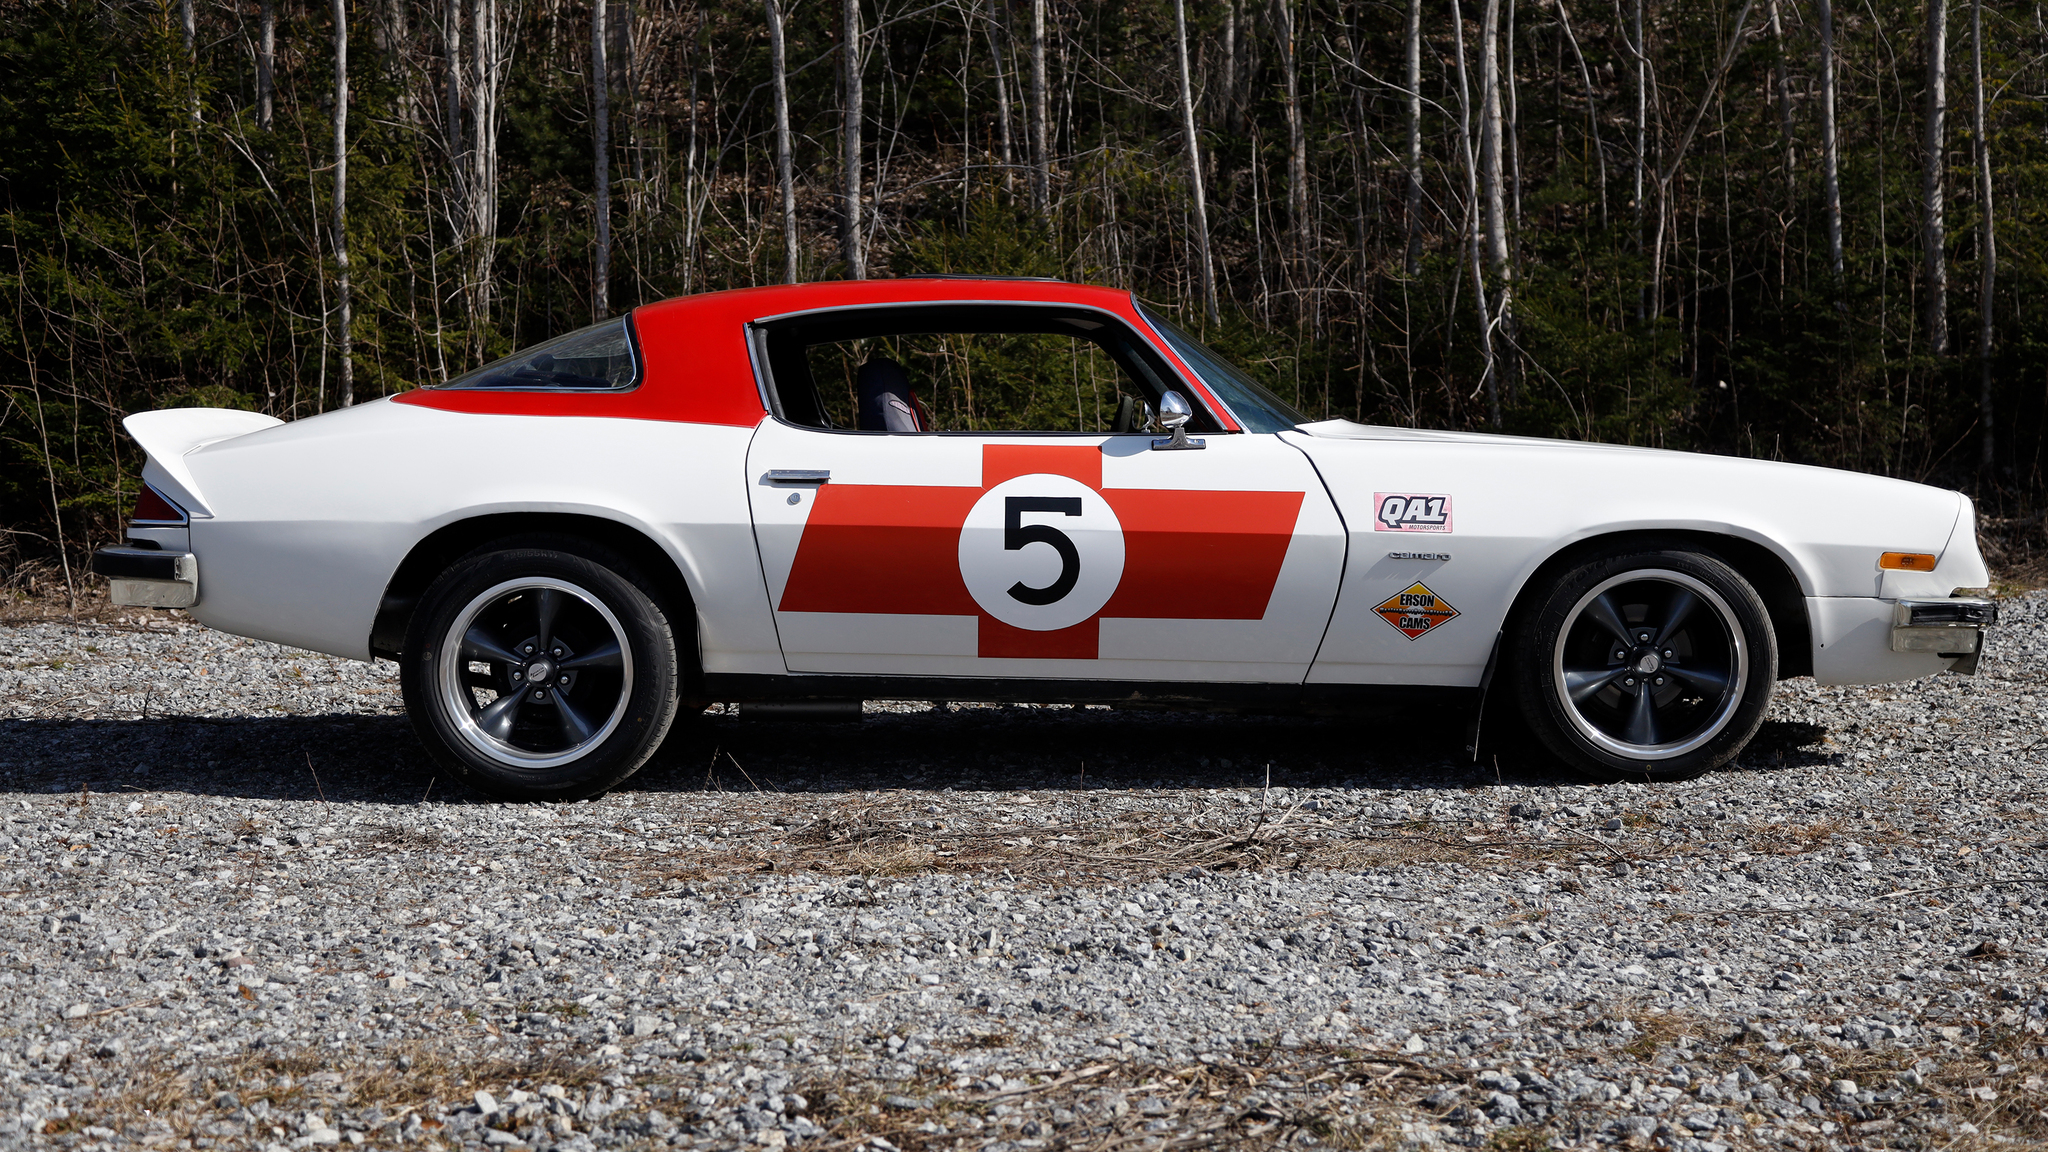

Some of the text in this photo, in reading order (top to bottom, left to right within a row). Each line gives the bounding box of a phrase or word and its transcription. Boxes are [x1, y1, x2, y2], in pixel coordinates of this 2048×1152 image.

[1378, 496, 1448, 528] QA1
[1004, 496, 1082, 606] 5
[1399, 593, 1435, 607] ERSON
[1399, 616, 1431, 630] CAMS
